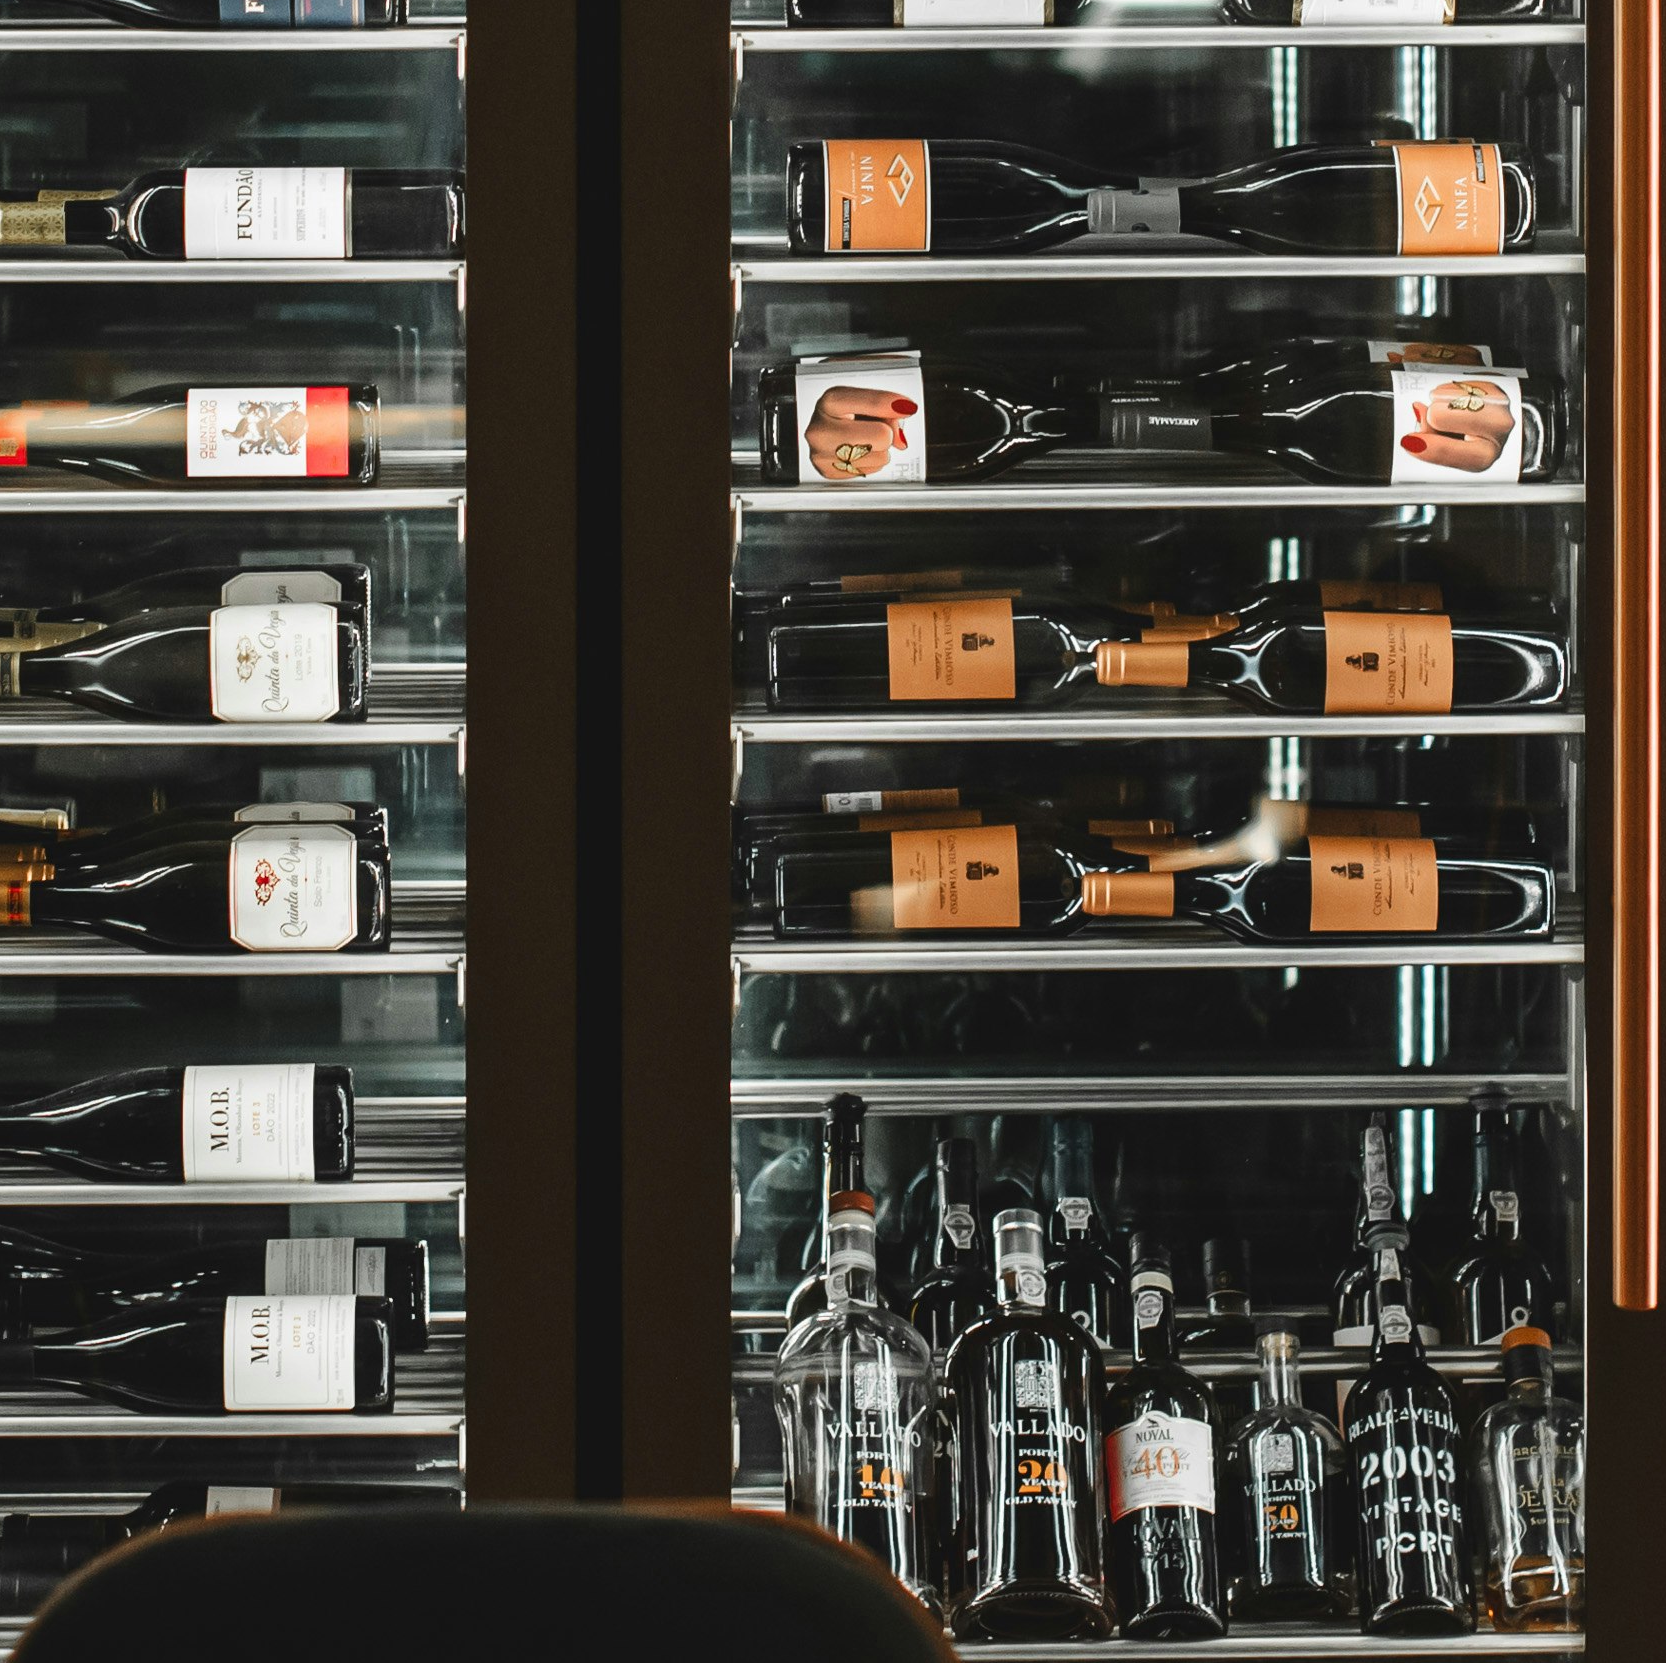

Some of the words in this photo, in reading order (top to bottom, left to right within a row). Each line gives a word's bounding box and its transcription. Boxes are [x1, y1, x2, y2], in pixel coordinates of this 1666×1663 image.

[860, 155, 875, 206] NINFA
[235, 169, 255, 241] FUNDÃO
[1454, 176, 1468, 230] NINFA
[199, 399, 209, 415] DO
[199, 416, 209, 460] QUINTA
[207, 399, 218, 460] PERDIGÃO
[257, 609, 285, 645] Vegia
[269, 650, 280, 664] da
[293, 632, 304, 659] 2019
[293, 660, 304, 682] Lote
[942, 638, 954, 686] VIMIOSO
[260, 668, 289, 713] Quinta
[1385, 669, 1396, 706] CONDE
[286, 874, 299, 888] da
[949, 868, 960, 915] VIMIOSO
[313, 887, 323, 908] Solo
[1371, 877, 1383, 916] CONDE
[279, 891, 308, 938] Quinta
[266, 1092, 276, 1115] 2022
[209, 1086, 231, 1154] M.O.B.
[251, 1110, 261, 1137] LOTE
[264, 1118, 276, 1144] DÃO
[250, 1304, 272, 1366] M.O.B.
[292, 1324, 302, 1349] LOTE
[305, 1330, 317, 1355] DÃO
[826, 1420, 922, 1448] VALLADO
[989, 1418, 1086, 1444] VALLADO
[1135, 1428, 1174, 1444] NOVAL
[1130, 1445, 1181, 1479] 40
[1361, 1445, 1455, 1489] 2003
[1017, 1460, 1068, 1495] 20
[1006, 1496, 1034, 1506] OLD
[1361, 1496, 1462, 1524] VINTAGE
[1263, 1503, 1299, 1531] 50
[1376, 1531, 1453, 1559] PORT
